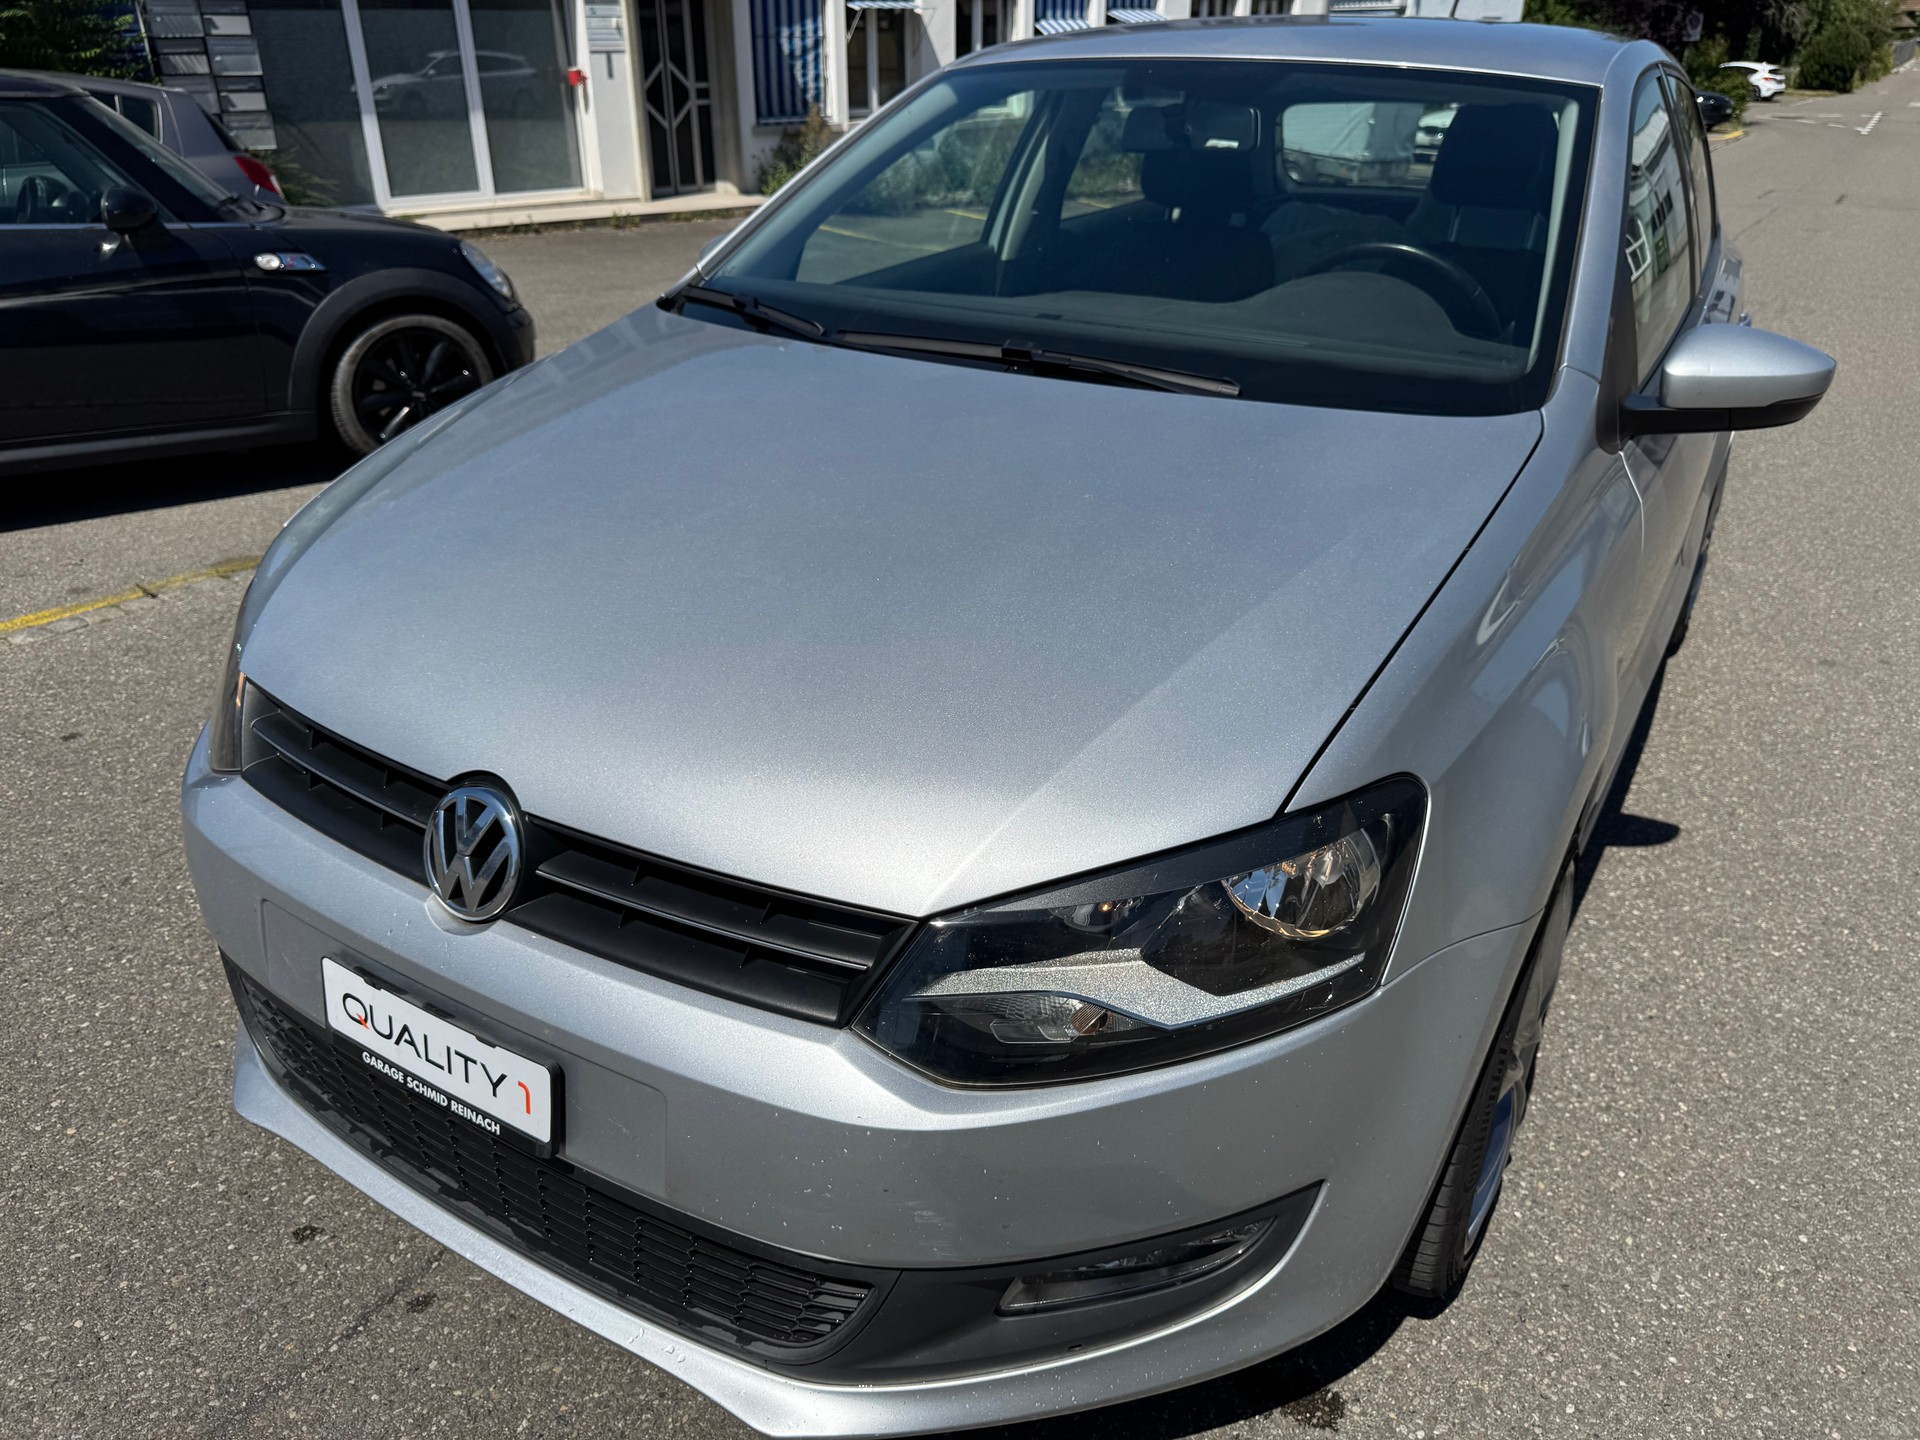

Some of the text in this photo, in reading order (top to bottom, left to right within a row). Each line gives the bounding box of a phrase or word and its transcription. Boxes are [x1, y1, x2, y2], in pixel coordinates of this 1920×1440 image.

[342, 992, 532, 1115] QUALITY 1
[362, 1051, 501, 1135] GARAGE SCHMID REINACH
